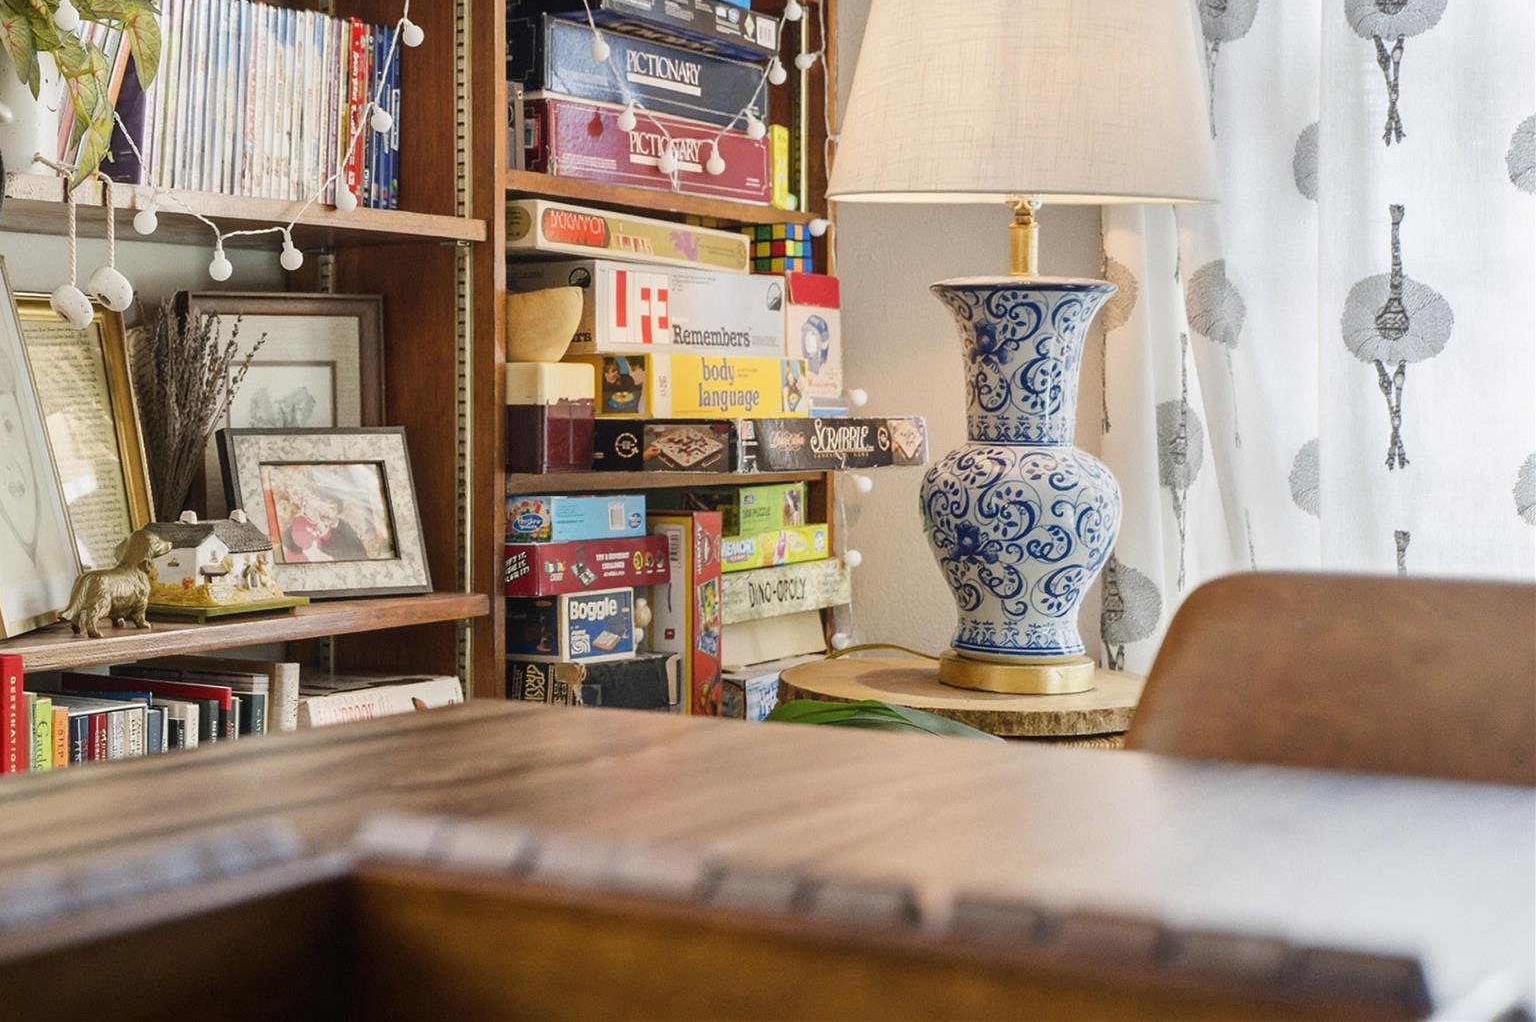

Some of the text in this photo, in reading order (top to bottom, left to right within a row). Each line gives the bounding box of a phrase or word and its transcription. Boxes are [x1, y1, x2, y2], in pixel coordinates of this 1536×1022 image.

[626, 49, 702, 85] PICTIONARY
[672, 324, 751, 348] Remembers
[702, 357, 735, 386] body
[698, 382, 760, 412] language
[810, 418, 869, 453] SCRABBLE
[749, 578, 806, 608] DINO-OPOLY
[569, 597, 618, 621] Boggle
